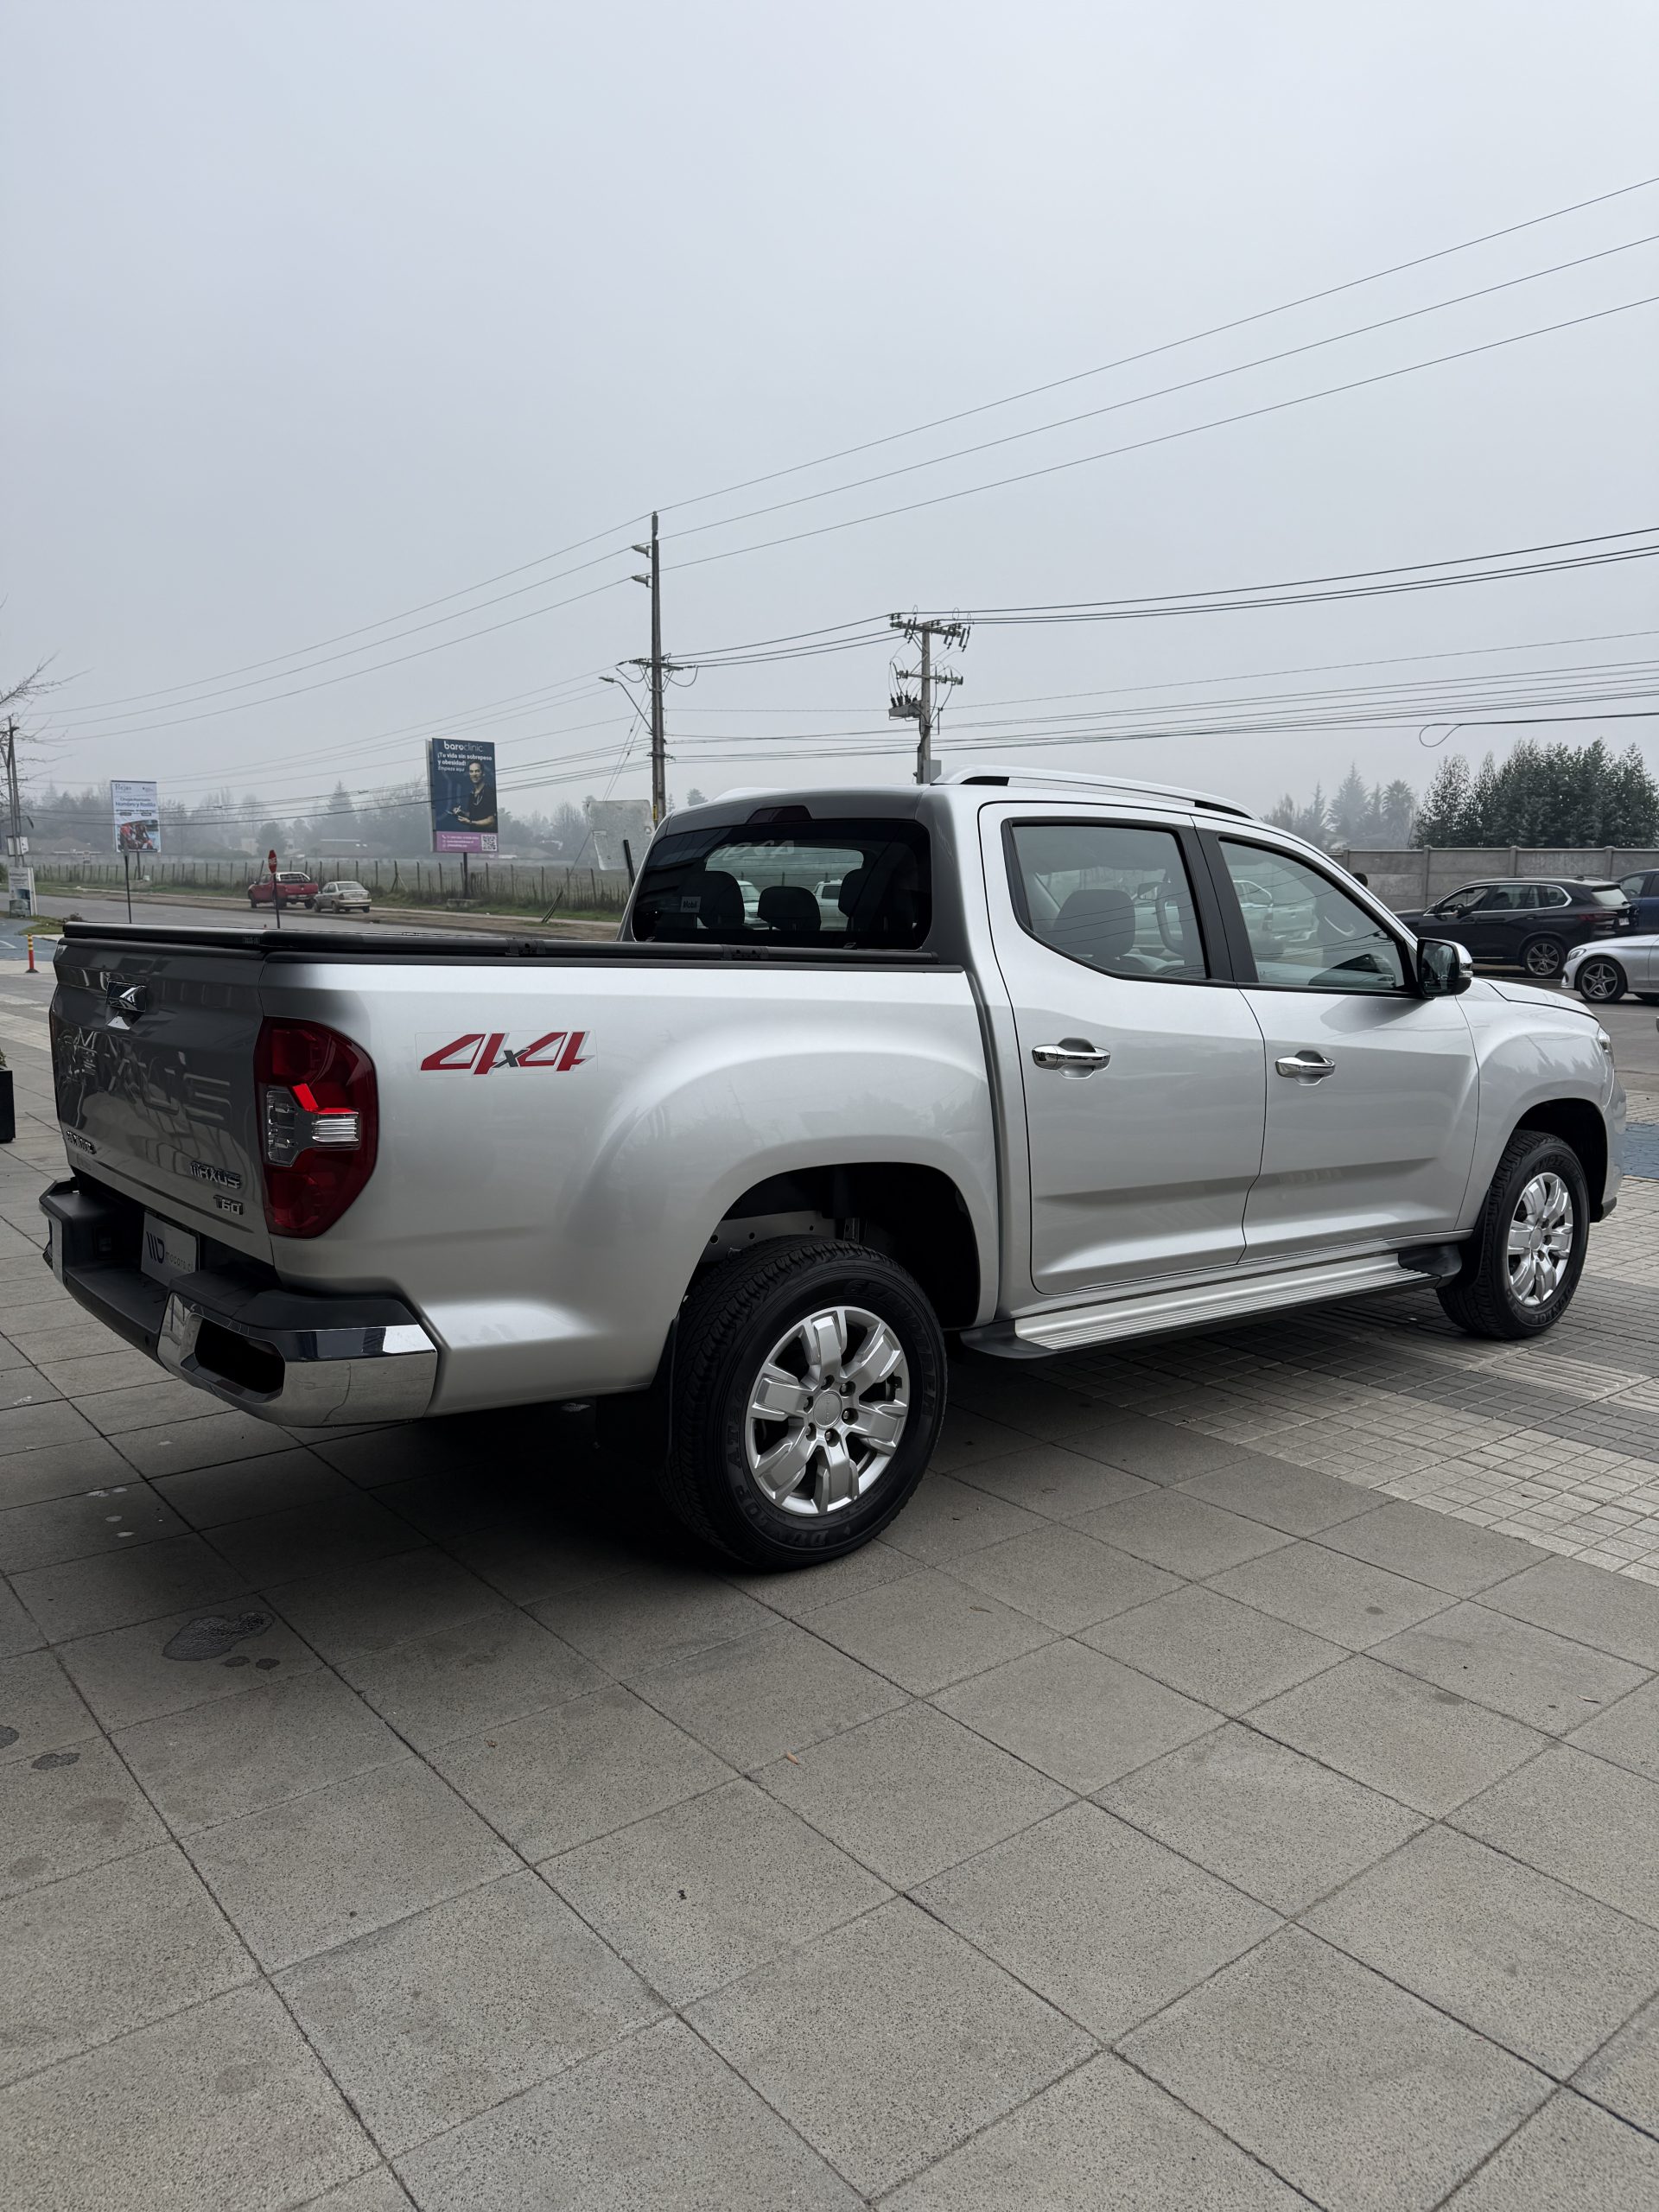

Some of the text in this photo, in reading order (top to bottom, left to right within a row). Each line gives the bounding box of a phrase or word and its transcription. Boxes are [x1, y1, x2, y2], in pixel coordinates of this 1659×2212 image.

[443, 741, 483, 753] baroclinic
[420, 1032, 589, 1075] 4x4
[190, 1160, 241, 1189] MAXUS
[213, 1194, 243, 1215] T60
